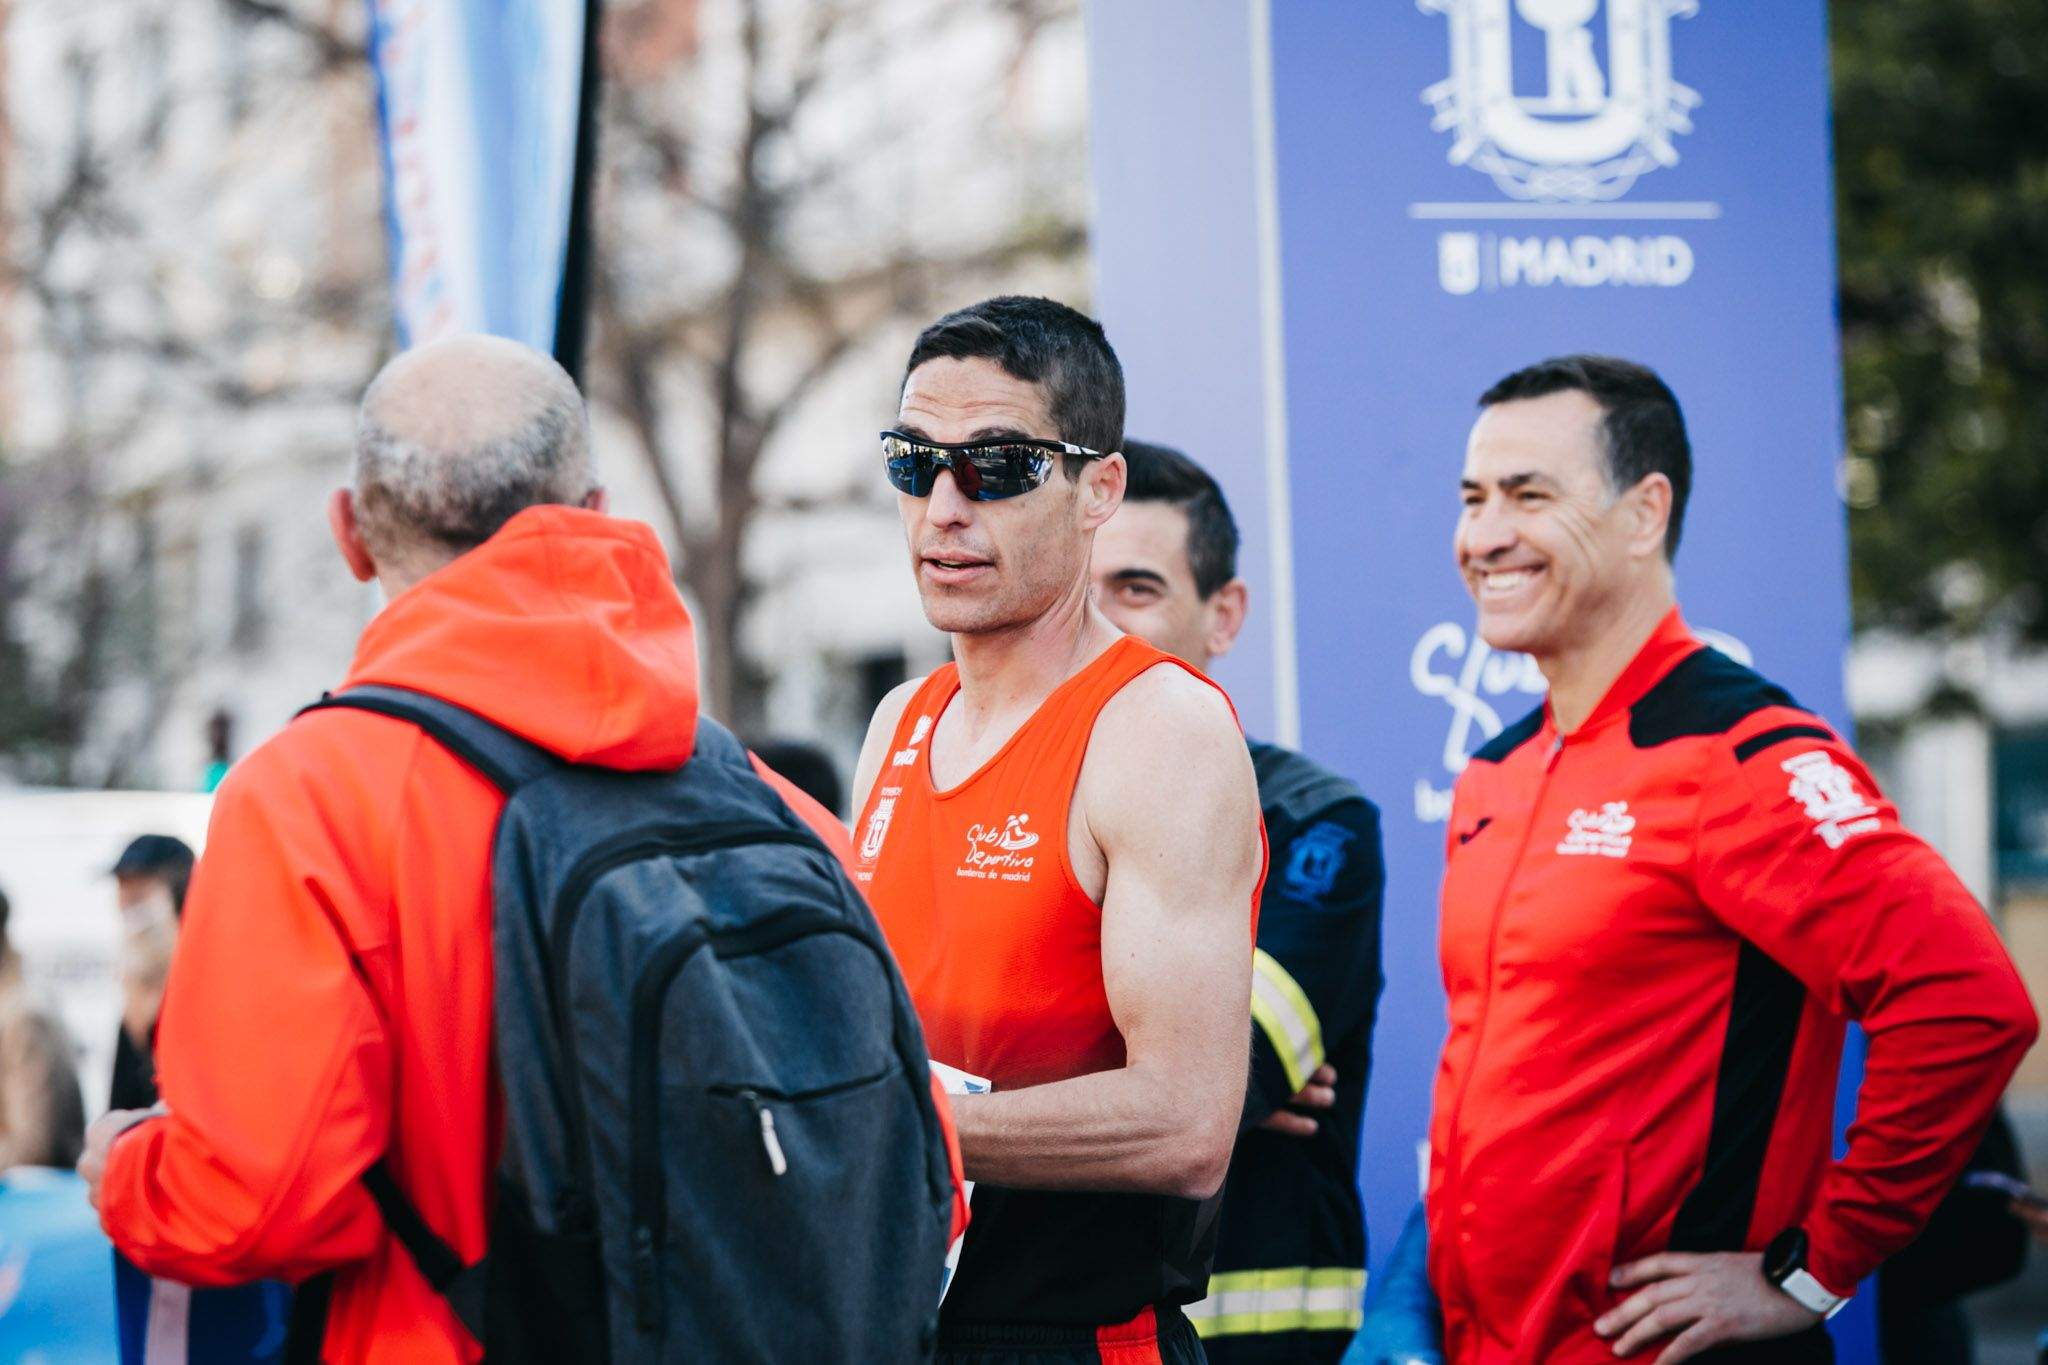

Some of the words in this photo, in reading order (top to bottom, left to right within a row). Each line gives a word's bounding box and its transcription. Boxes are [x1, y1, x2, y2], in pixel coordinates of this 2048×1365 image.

[1500, 234, 1694, 287] MADRID
[967, 823, 999, 843] Club
[965, 841, 1035, 869] Deportivo
[1001, 871, 1031, 882] madrid
